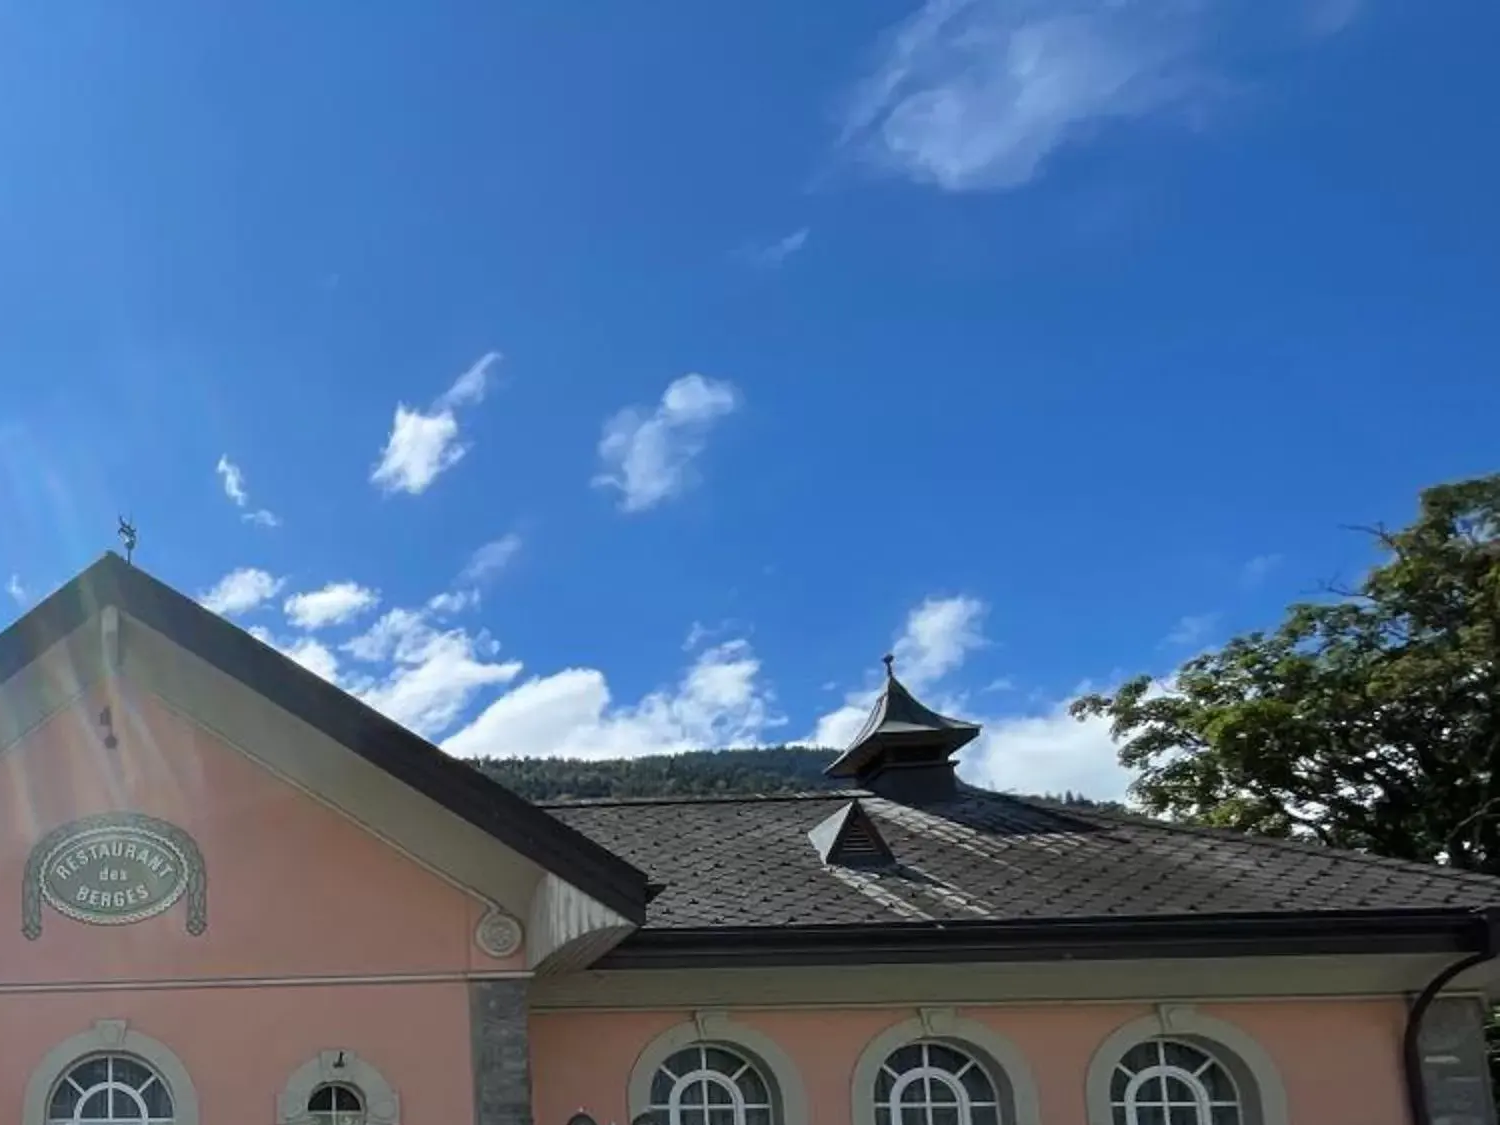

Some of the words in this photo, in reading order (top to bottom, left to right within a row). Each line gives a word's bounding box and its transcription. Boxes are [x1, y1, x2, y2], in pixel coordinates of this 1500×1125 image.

[56, 842, 173, 880] RESTAURANT
[99, 866, 127, 881] des
[76, 884, 149, 907] BERGES
